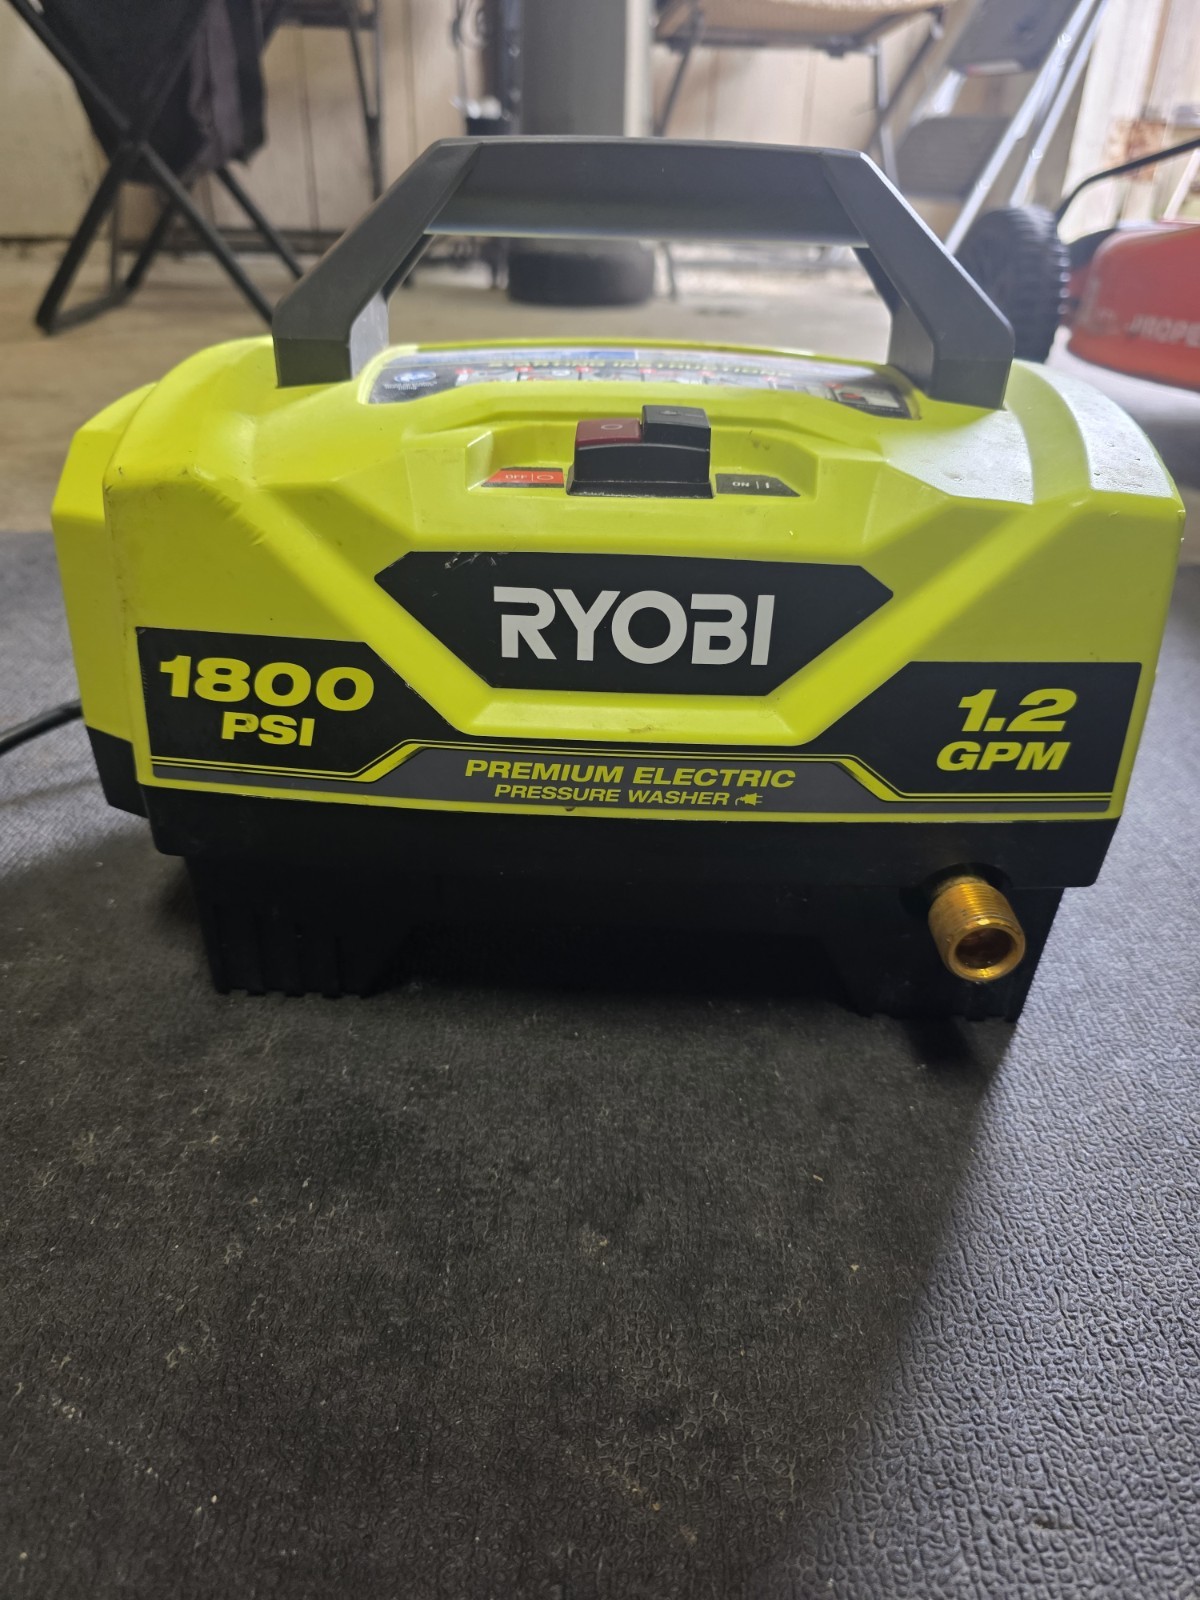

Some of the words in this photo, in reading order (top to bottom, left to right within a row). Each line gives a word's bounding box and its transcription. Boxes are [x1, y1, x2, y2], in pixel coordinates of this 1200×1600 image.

[493, 585, 776, 666] RYOBI
[159, 655, 375, 712] 1800
[958, 688, 1078, 732] 1.2
[221, 711, 316, 747] PSI
[465, 759, 625, 784] PREMIUM
[632, 766, 797, 788] ELECTRIC
[936, 741, 1072, 771] GPM
[494, 785, 622, 802] PRESSURE
[628, 790, 730, 806] WASHER
